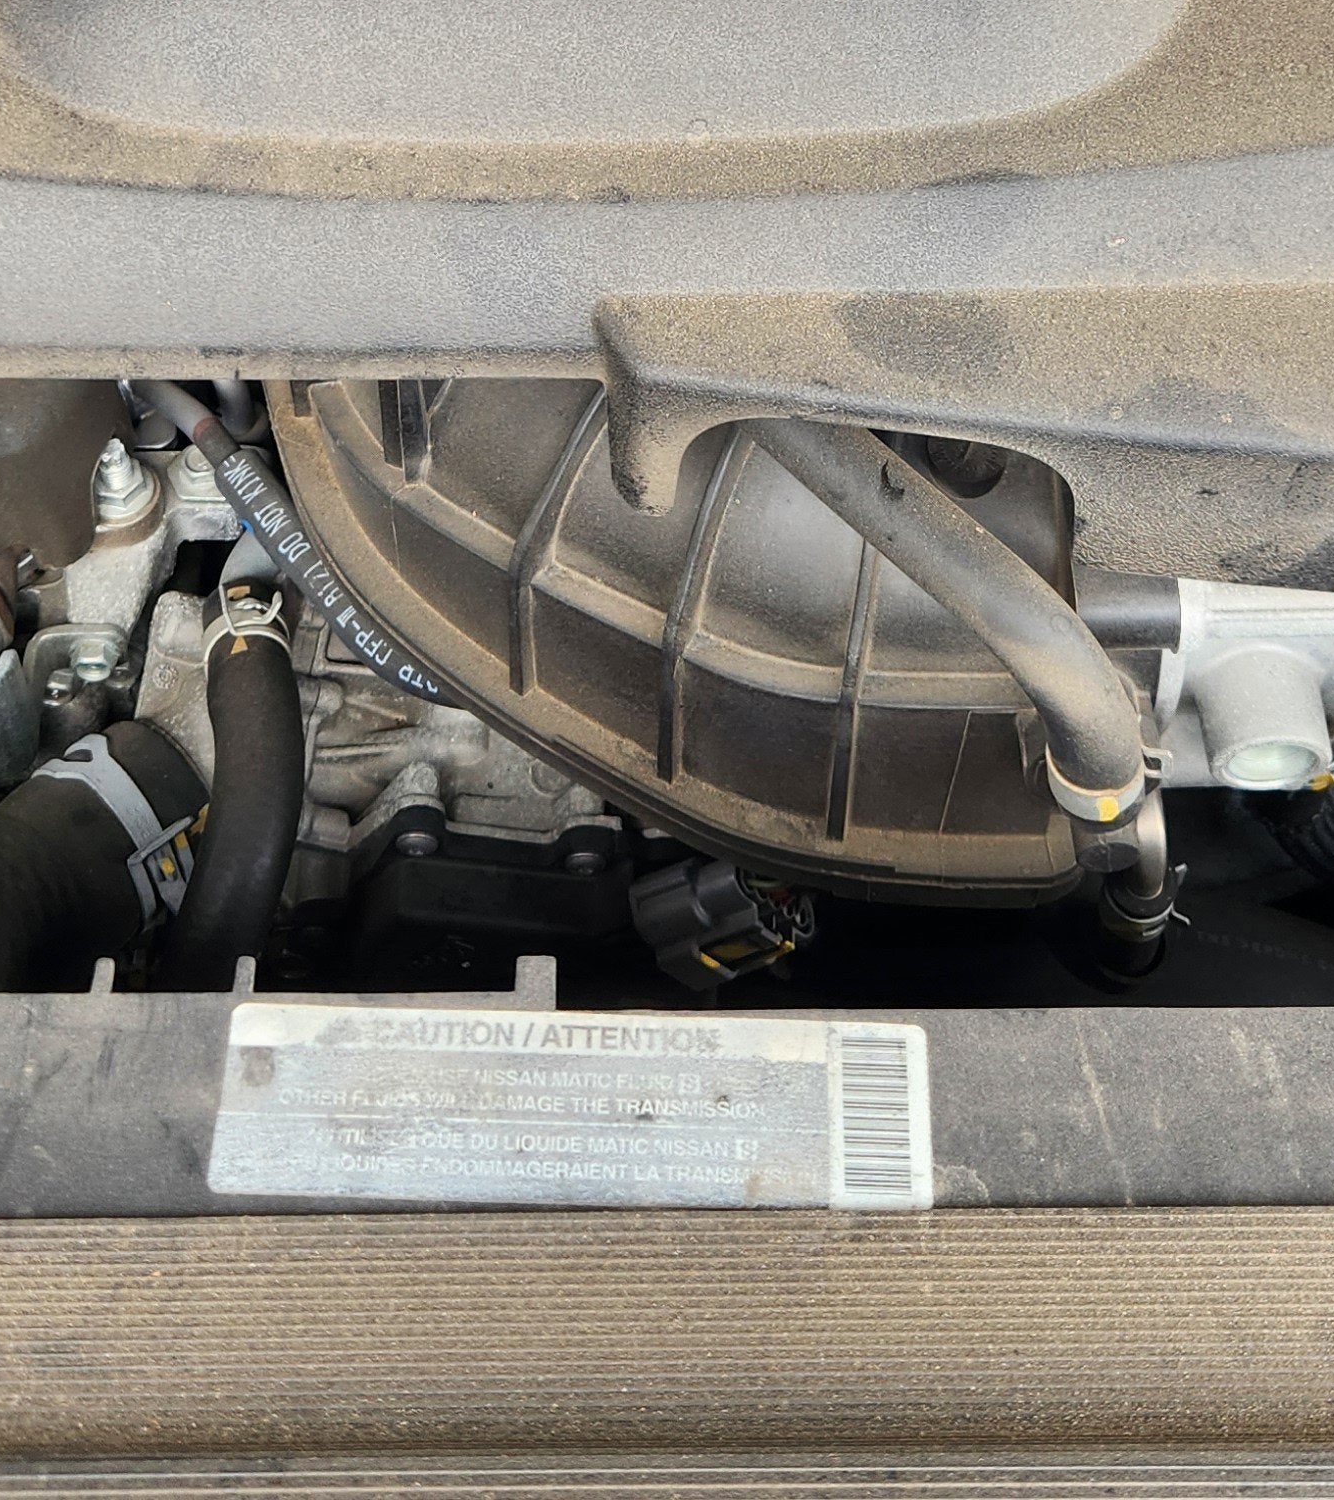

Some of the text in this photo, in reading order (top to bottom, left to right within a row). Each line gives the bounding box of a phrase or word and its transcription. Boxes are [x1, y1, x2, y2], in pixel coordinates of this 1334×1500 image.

[253, 505, 294, 542] NOT
[277, 532, 310, 564] DO
[474, 1069, 547, 1088] NISSAN
[570, 1097, 611, 1116] THE
[616, 1098, 767, 1120] TRANSMISSION
[471, 1133, 498, 1151] DU
[503, 1134, 584, 1153] LIQUIDE
[588, 1136, 649, 1155] MATIC
[653, 1138, 730, 1159] NISSAN
[633, 1165, 660, 1182] LA
